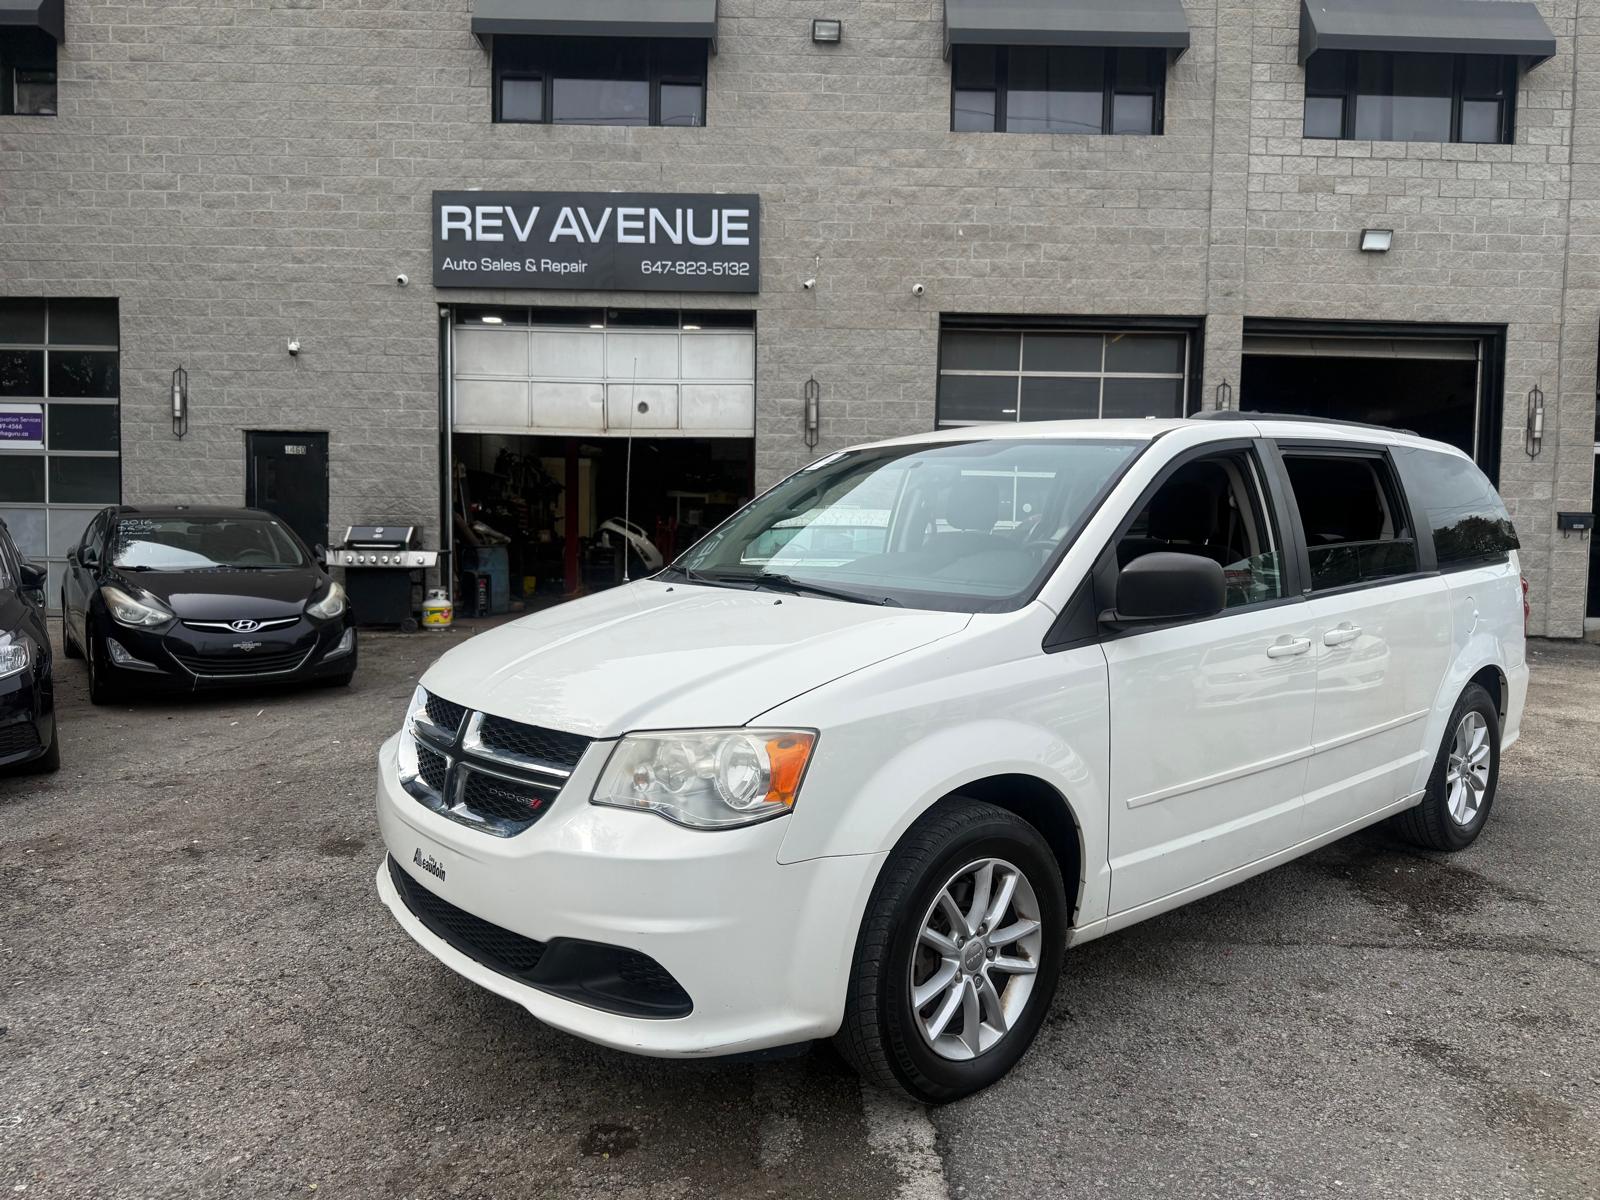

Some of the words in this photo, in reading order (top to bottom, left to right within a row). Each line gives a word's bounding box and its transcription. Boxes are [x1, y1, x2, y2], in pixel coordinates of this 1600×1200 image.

[441, 205, 540, 242] REV
[549, 206, 750, 246] AVENUE
[442, 257, 478, 272] Auto
[480, 258, 521, 273] Sales
[525, 259, 538, 273] &
[540, 259, 588, 276] Repair
[641, 261, 750, 276] 647-823-5132
[489, 787, 533, 806] DODGE
